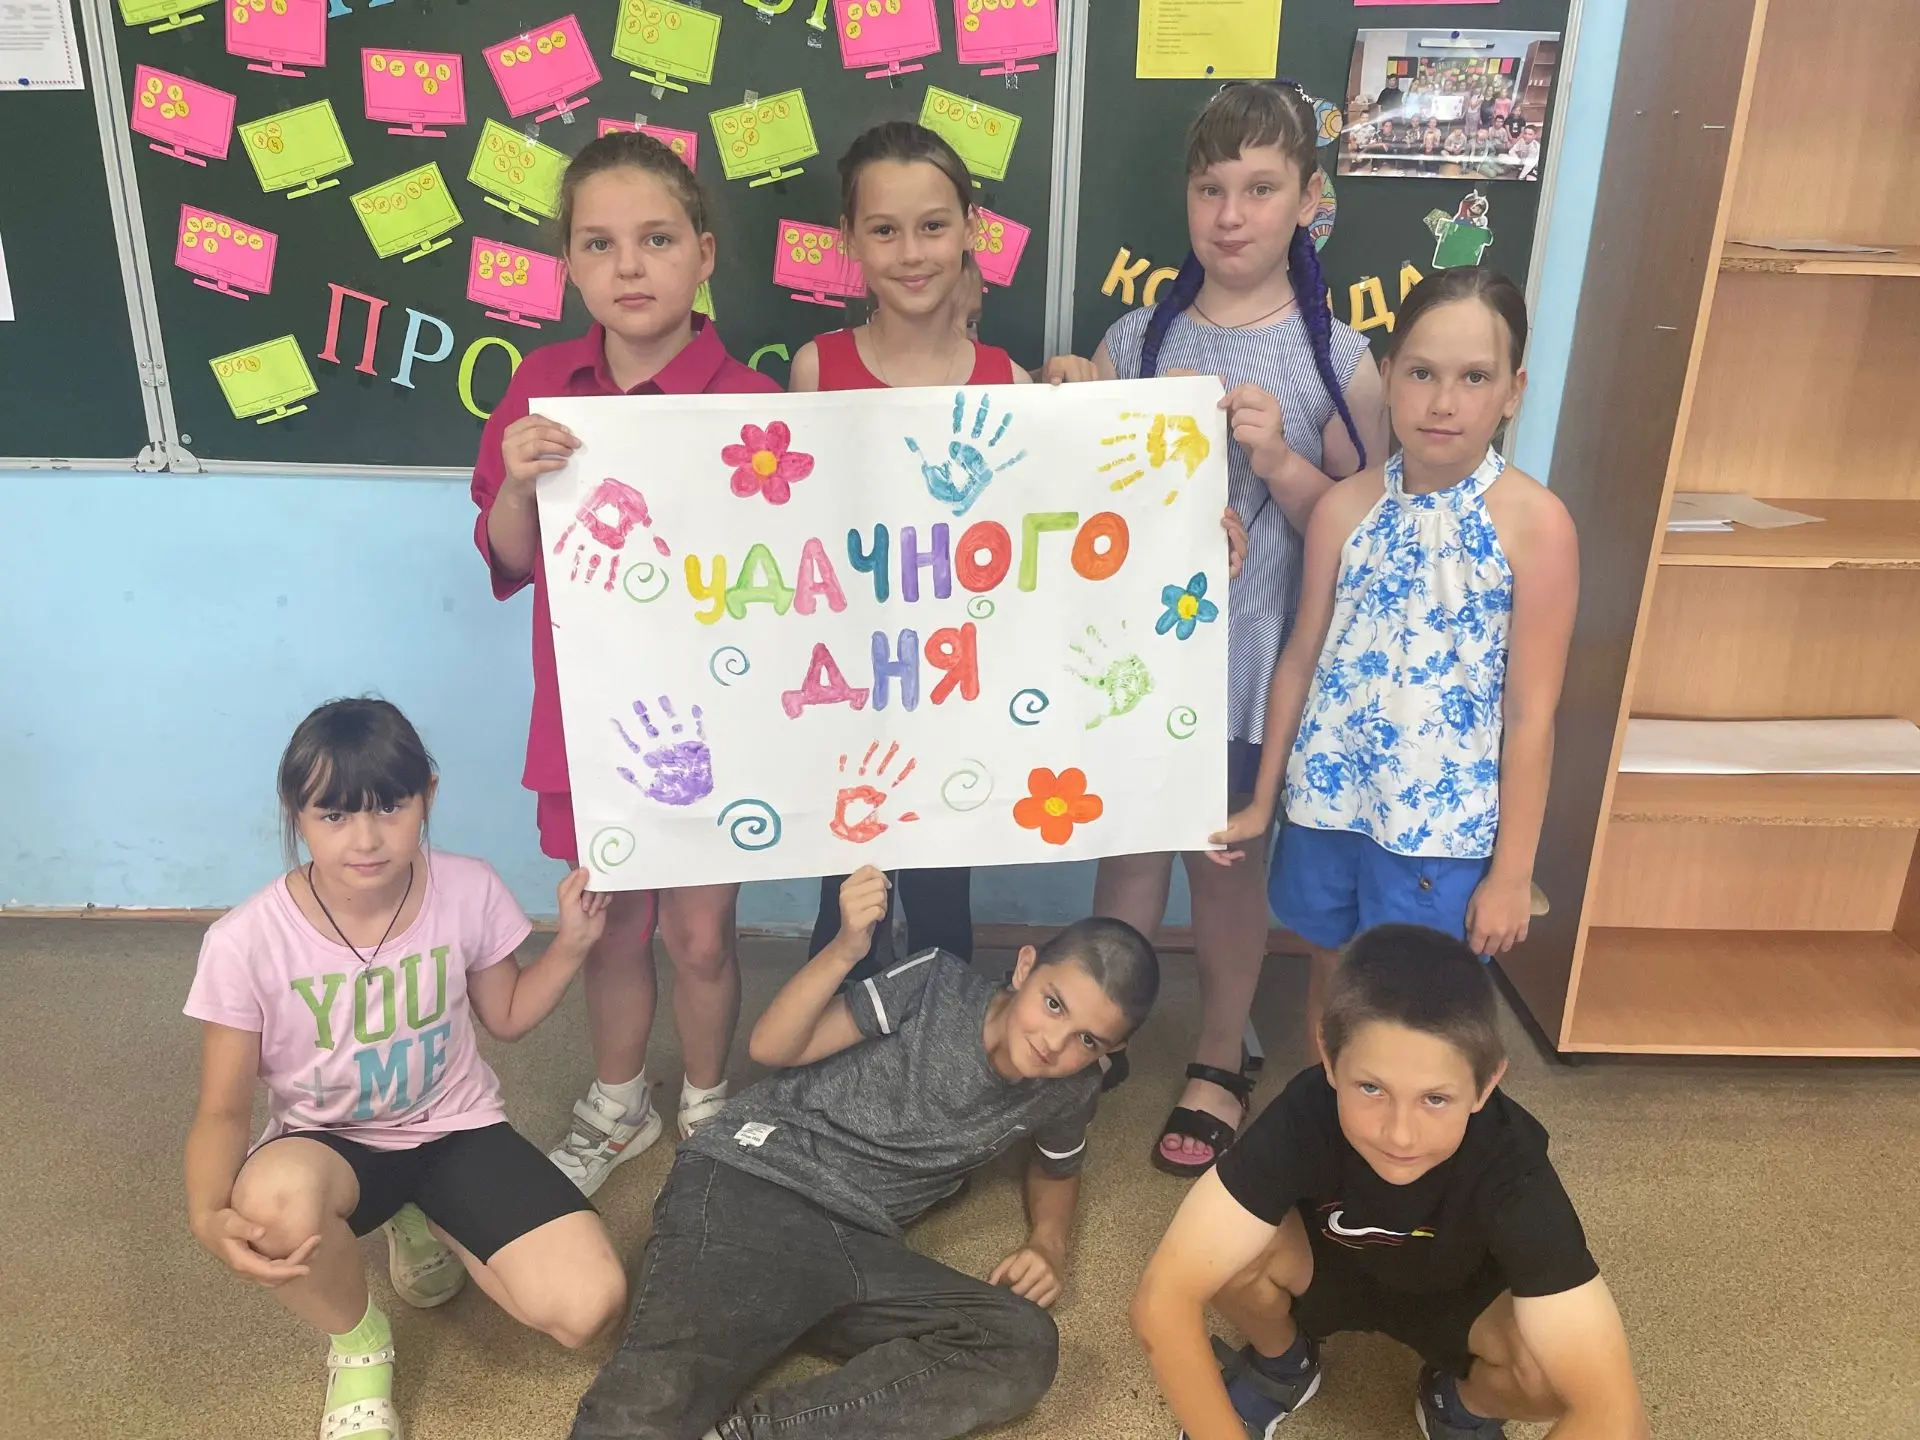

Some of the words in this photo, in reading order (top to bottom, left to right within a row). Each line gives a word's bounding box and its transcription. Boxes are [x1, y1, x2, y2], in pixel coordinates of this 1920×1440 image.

[684, 511, 1130, 625] УДАЧНОГО
[781, 622, 980, 720] ДНЯ
[290, 945, 450, 1051] YOU
[352, 1021, 451, 1121] ME
